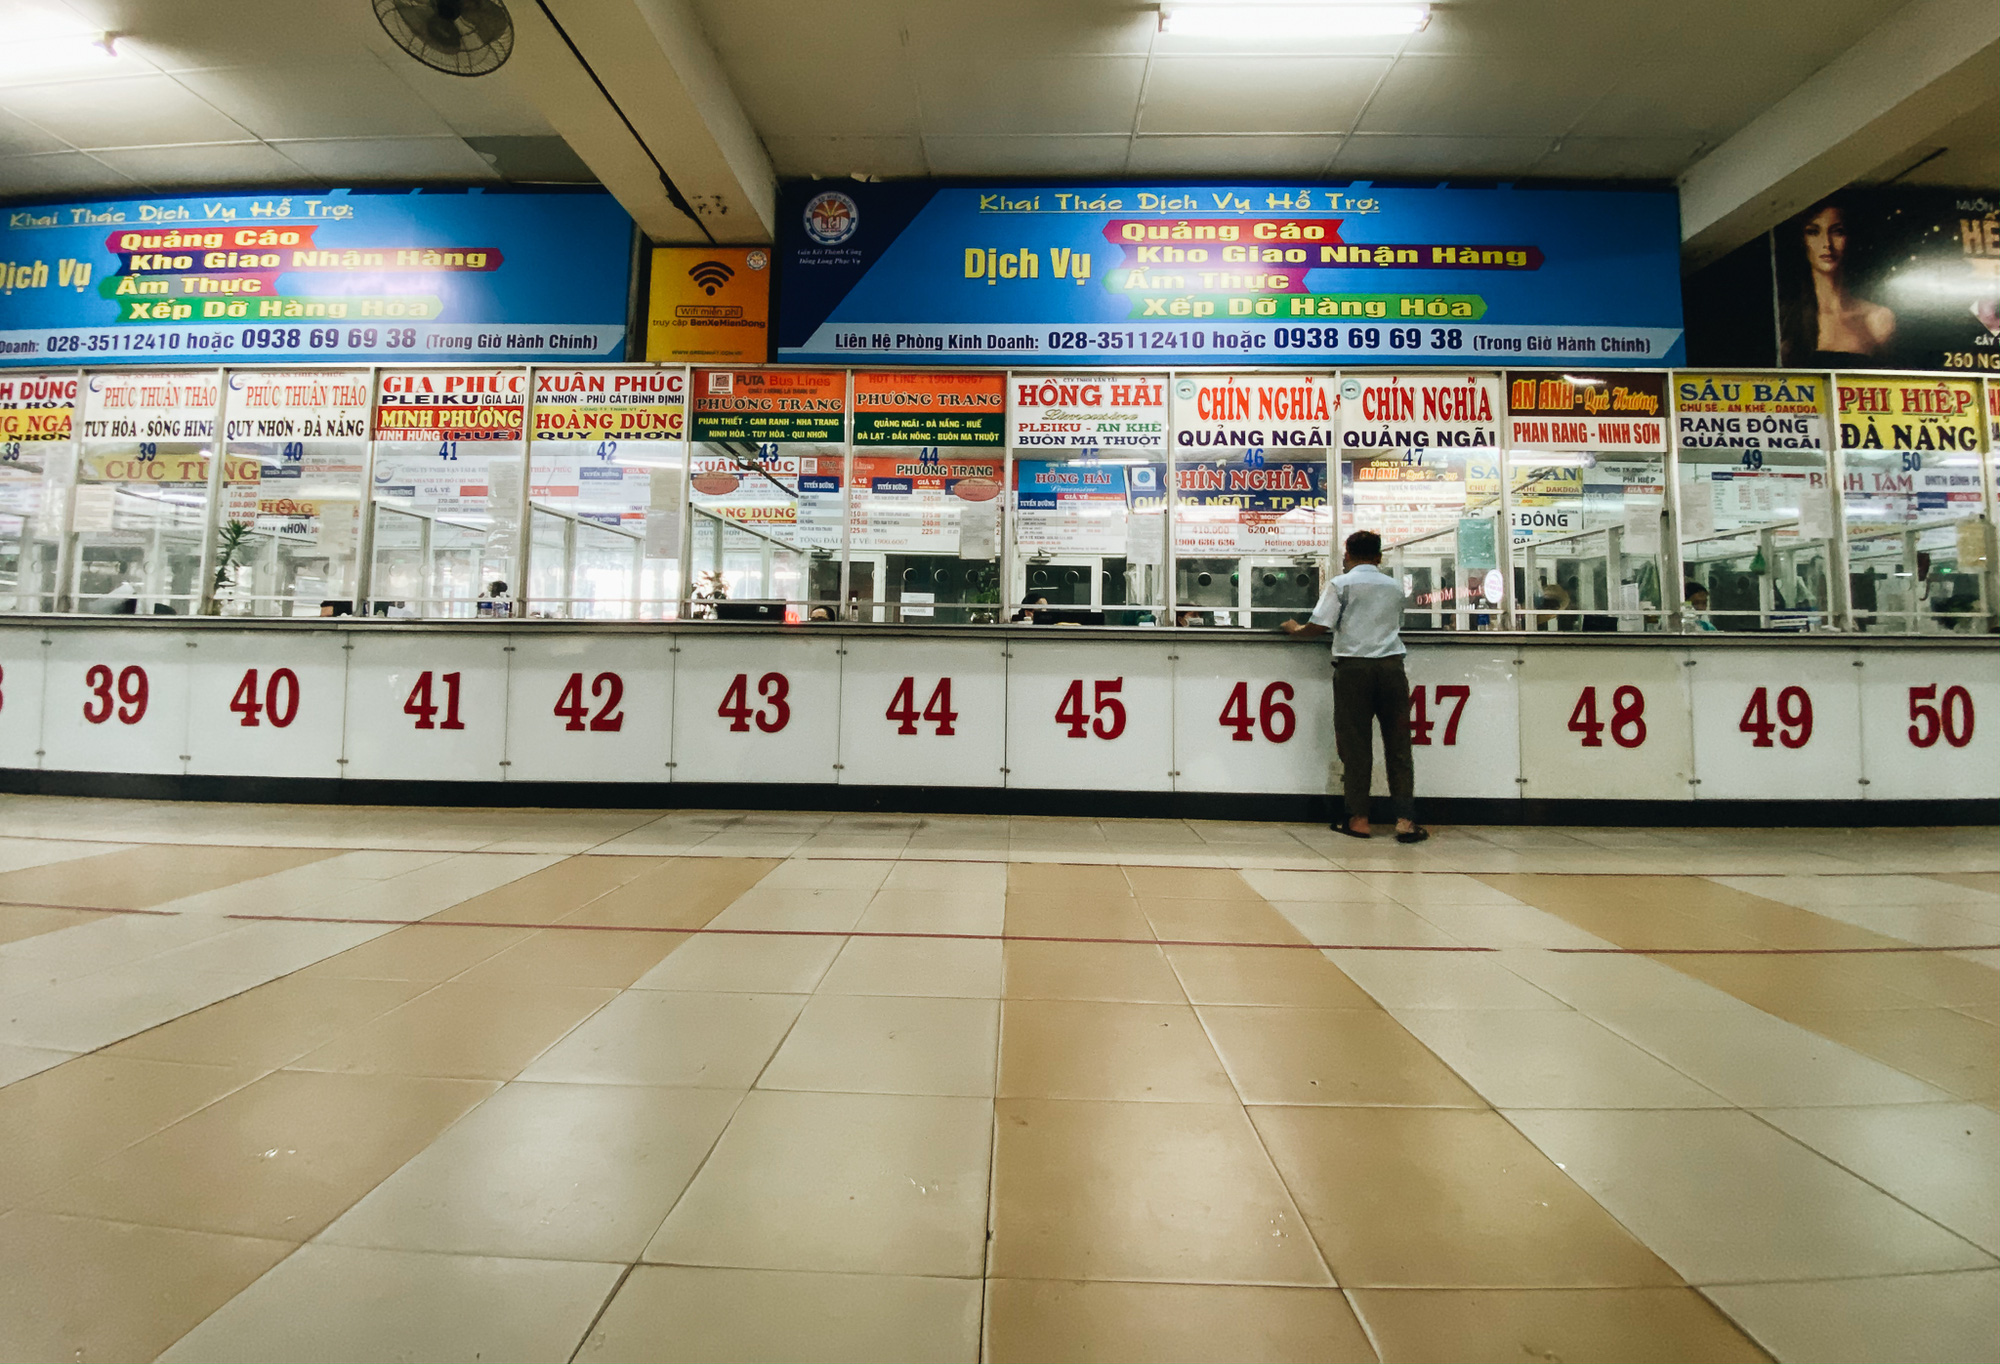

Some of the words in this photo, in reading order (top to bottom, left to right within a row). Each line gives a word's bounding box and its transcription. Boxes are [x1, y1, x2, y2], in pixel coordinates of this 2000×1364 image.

[120, 230, 224, 250] Quảng
[234, 228, 300, 247] Cáo
[1121, 221, 1240, 241] Quảng
[1253, 221, 1326, 239] Cáo
[130, 253, 193, 271] Kho
[204, 252, 280, 268] Giao
[293, 250, 383, 269] Nhận
[397, 249, 487, 268] Hàng
[964, 248, 1039, 285] Dịch
[1049, 249, 1091, 285] Vụ
[1137, 246, 1208, 263] Kho
[1221, 246, 1307, 263] Giao
[1320, 246, 1419, 266] Nhận
[1432, 247, 1527, 267] Hàng
[835, 334, 867, 349] Liên
[872, 334, 891, 352] Hệ
[896, 334, 943, 351] Phòng
[949, 334, 982, 350] Kinh
[987, 334, 1039, 350] Doanh:
[1048, 331, 1205, 350] 028-35112410
[1212, 329, 1266, 352] hoặc
[1273, 328, 1339, 349] 0938
[1348, 328, 1381, 349] 69
[1389, 328, 1422, 349] 69
[1430, 329, 1463, 349] 38
[1473, 336, 1522, 352] (Trong
[1526, 335, 1552, 351] Giờ
[1556, 335, 1596, 351] Hành
[1600, 336, 1651, 353] Chính)
[1944, 353, 1973, 367] 260
[383, 376, 433, 393] GIA
[445, 371, 525, 393] PHÚC
[537, 371, 605, 392] XUÂN
[614, 371, 683, 392] PHÚC
[736, 375, 765, 386] FUTA
[769, 375, 794, 386] Bus
[798, 375, 831, 386] Lines
[869, 374, 890, 383] HOT
[894, 374, 917, 383] LINE
[928, 375, 954, 383] 1900
[103, 382, 136, 408] PHÚC
[140, 381, 181, 414] THUẬN
[184, 377, 218, 407] THẢO
[246, 380, 280, 406] PHÚC
[285, 380, 328, 412] THUẬN
[332, 377, 366, 406] THẢO
[381, 394, 479, 405] PLEIKU
[482, 394, 502, 405] (GIA
[505, 394, 524, 405] LAI)
[856, 391, 932, 406] PHƯƠNG
[937, 393, 1002, 406] TRANG
[1018, 378, 1102, 407] HỒNG
[1110, 378, 1163, 407] HẢI
[1198, 377, 1250, 420] CHÍN
[1258, 377, 1329, 420] NGHĨA
[1362, 377, 1415, 421] CHÍN
[1422, 377, 1493, 421] NGHĨA
[1512, 379, 1536, 409] AN
[1539, 380, 1574, 409] ANH
[1612, 387, 1659, 415] Hương
[1680, 379, 1740, 401] SÁU
[1753, 378, 1815, 403] BẢN
[697, 396, 773, 410] PHƯƠNG
[777, 398, 843, 411] TRANG
[1680, 403, 1702, 412] CHƯ
[1728, 404, 1741, 412] AN
[1745, 403, 1766, 412] KHÊ
[1837, 387, 1891, 412] PHI
[1900, 382, 1971, 422] HIỆP
[381, 409, 434, 428] MINH
[438, 406, 522, 428] PHƯƠNG
[535, 409, 613, 429] HOÀNG
[620, 409, 683, 429] DŨNG
[720, 415, 743, 425] THIẾT
[874, 418, 899, 427] QUẢNG
[901, 418, 919, 427] NGÃI
[926, 418, 937, 427] ĐÀ
[939, 417, 959, 428] NẴNG
[966, 418, 982, 427] HUẾ
[1018, 423, 1081, 432] PLEIKU
[1096, 423, 1121, 432] AN
[1126, 421, 1161, 432] KHÊ
[8, 432, 71, 441] NHƠN
[537, 432, 592, 440] QUY
[604, 430, 681, 439] NHƠN
[769, 430, 785, 438] HÒA
[807, 430, 828, 438] NHƠN
[857, 431, 868, 440] ĐÀ
[870, 432, 885, 441] LẠT
[910, 431, 931, 440] NÔNG
[937, 431, 959, 440] BUÔN
[974, 432, 999, 442] THUỘT
[1019, 434, 1066, 445] BUÔN
[1071, 436, 1098, 445] MA
[1103, 434, 1161, 447] THUỘT
[1178, 424, 1264, 446] QUẢNG
[1272, 426, 1331, 446] NGÃI
[1343, 425, 1429, 447] QUẢNG
[1437, 427, 1495, 447] NGÃI
[1513, 422, 1549, 442] PHAN
[1552, 423, 1588, 443] RANG
[1598, 423, 1631, 443] NINH
[1634, 422, 1660, 444] SƠN
[1682, 434, 1760, 447] QUẢNG
[1768, 435, 1820, 449] NGÃI
[1840, 416, 1883, 449] ĐÀ
[1891, 418, 1977, 451] NẴNG
[138, 443, 156, 461] 39
[283, 442, 303, 461] 40
[439, 441, 458, 461] 41
[597, 441, 617, 461] 42
[758, 443, 779, 462] 43
[919, 447, 939, 466] 44
[1244, 448, 1264, 467] 46
[1402, 448, 1424, 466] 47
[1902, 452, 1921, 471] 50
[1360, 468, 1375, 479] AN
[1376, 468, 1399, 479] ANH
[83, 665, 149, 724] 39
[230, 668, 300, 728] 40
[403, 671, 465, 729] 41
[553, 671, 624, 732] 42
[718, 671, 791, 732] 43
[885, 677, 959, 736] 44
[1054, 677, 1126, 740] 45
[1218, 681, 1296, 743] 46
[1567, 685, 1647, 748] 48
[1739, 685, 1813, 748] 49
[1908, 683, 1974, 748] 50
